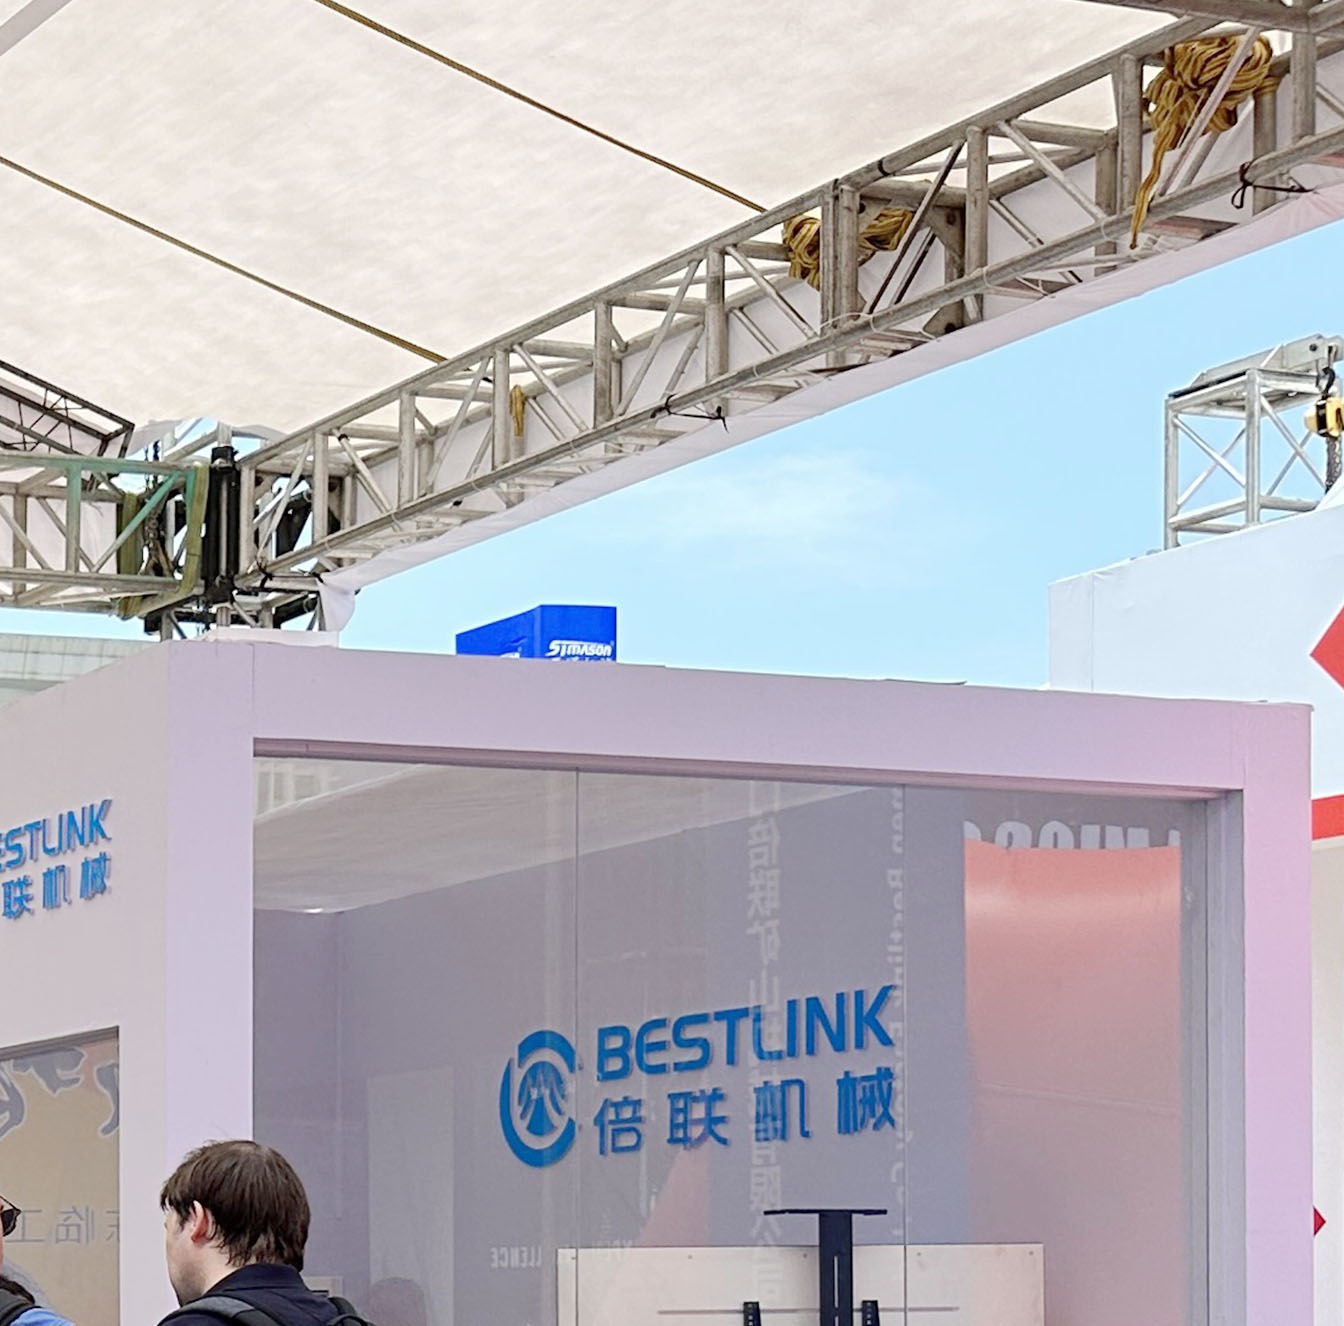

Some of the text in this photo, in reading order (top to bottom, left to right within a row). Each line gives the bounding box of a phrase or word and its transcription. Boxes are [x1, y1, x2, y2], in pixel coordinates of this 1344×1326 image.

[596, 984, 897, 1083] BESTLINK
[593, 1066, 897, 1157] 倍联机械
